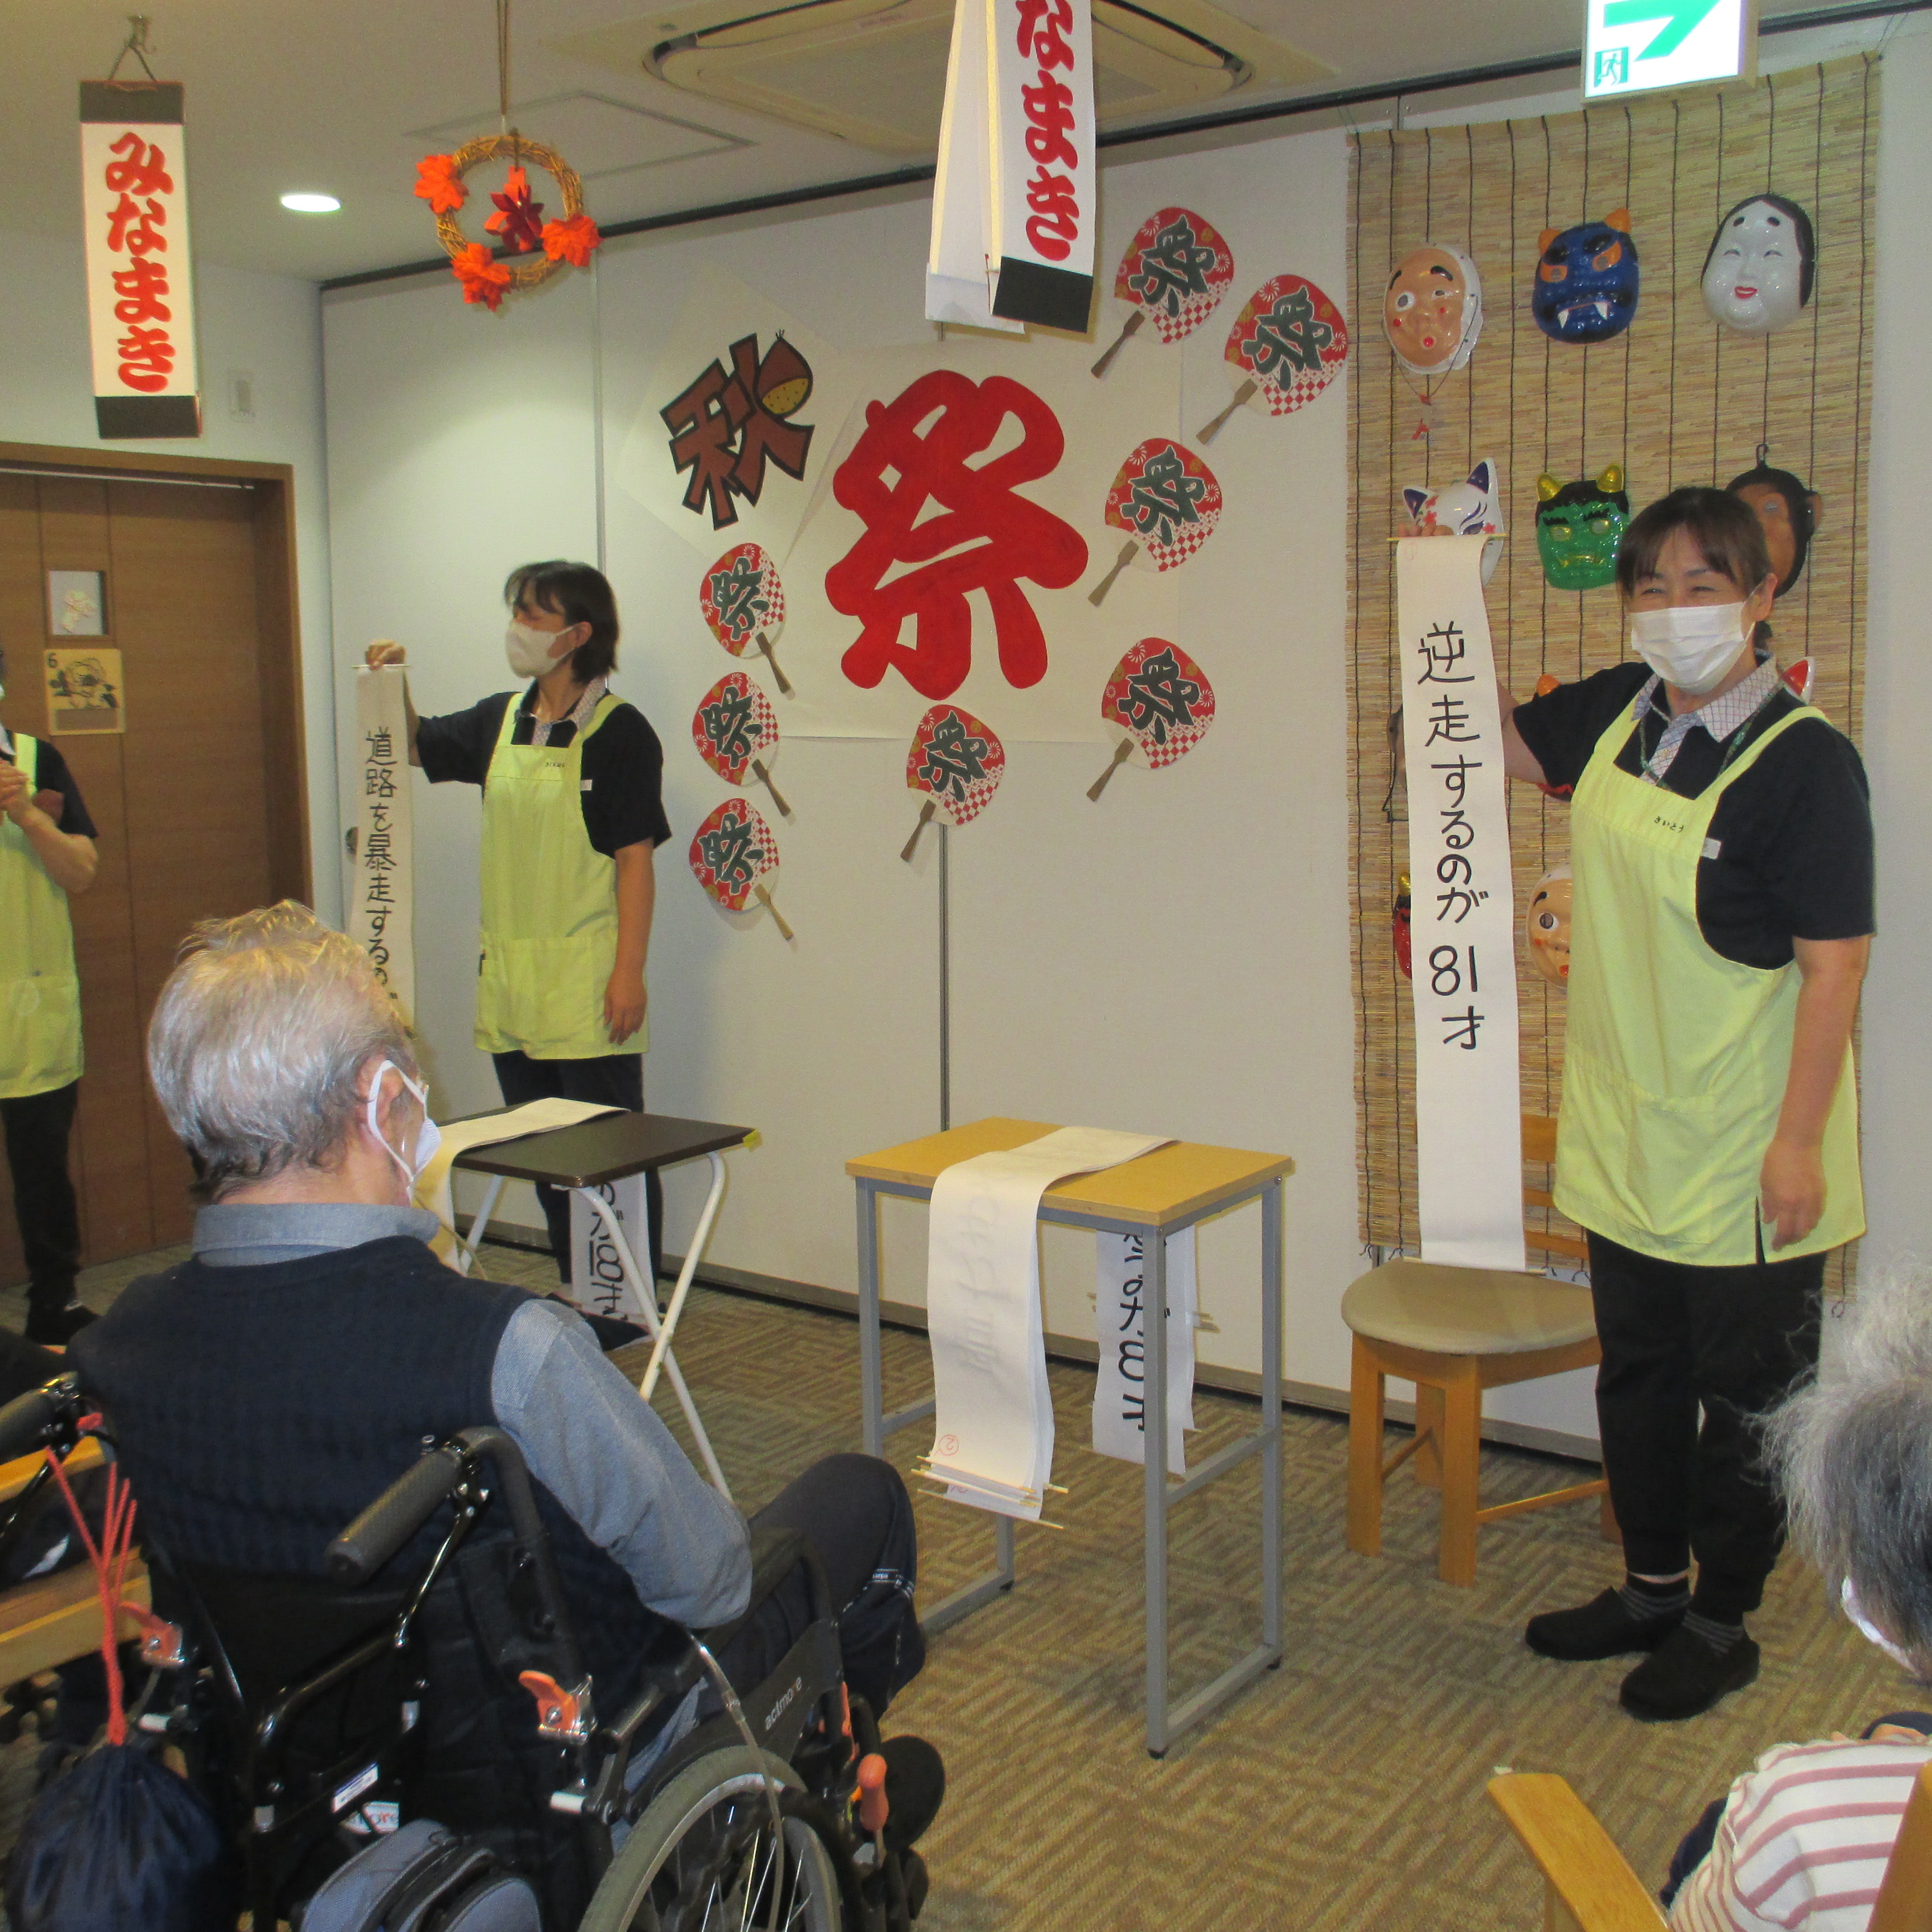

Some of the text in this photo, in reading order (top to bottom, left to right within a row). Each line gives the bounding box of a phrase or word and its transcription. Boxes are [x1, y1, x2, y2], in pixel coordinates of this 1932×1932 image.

[105, 132, 174, 392] みなまき
[1128, 214, 1216, 318] 祭
[1242, 286, 1333, 392] 祭
[660, 329, 815, 531] 秋
[825, 370, 1089, 700] 祭
[1119, 445, 1205, 546] 祭
[710, 557, 770, 641] 祭
[700, 685, 764, 769] 祭
[1117, 647, 1200, 745] 祭
[918, 710, 988, 802] 祭
[698, 812, 764, 895] 祭
